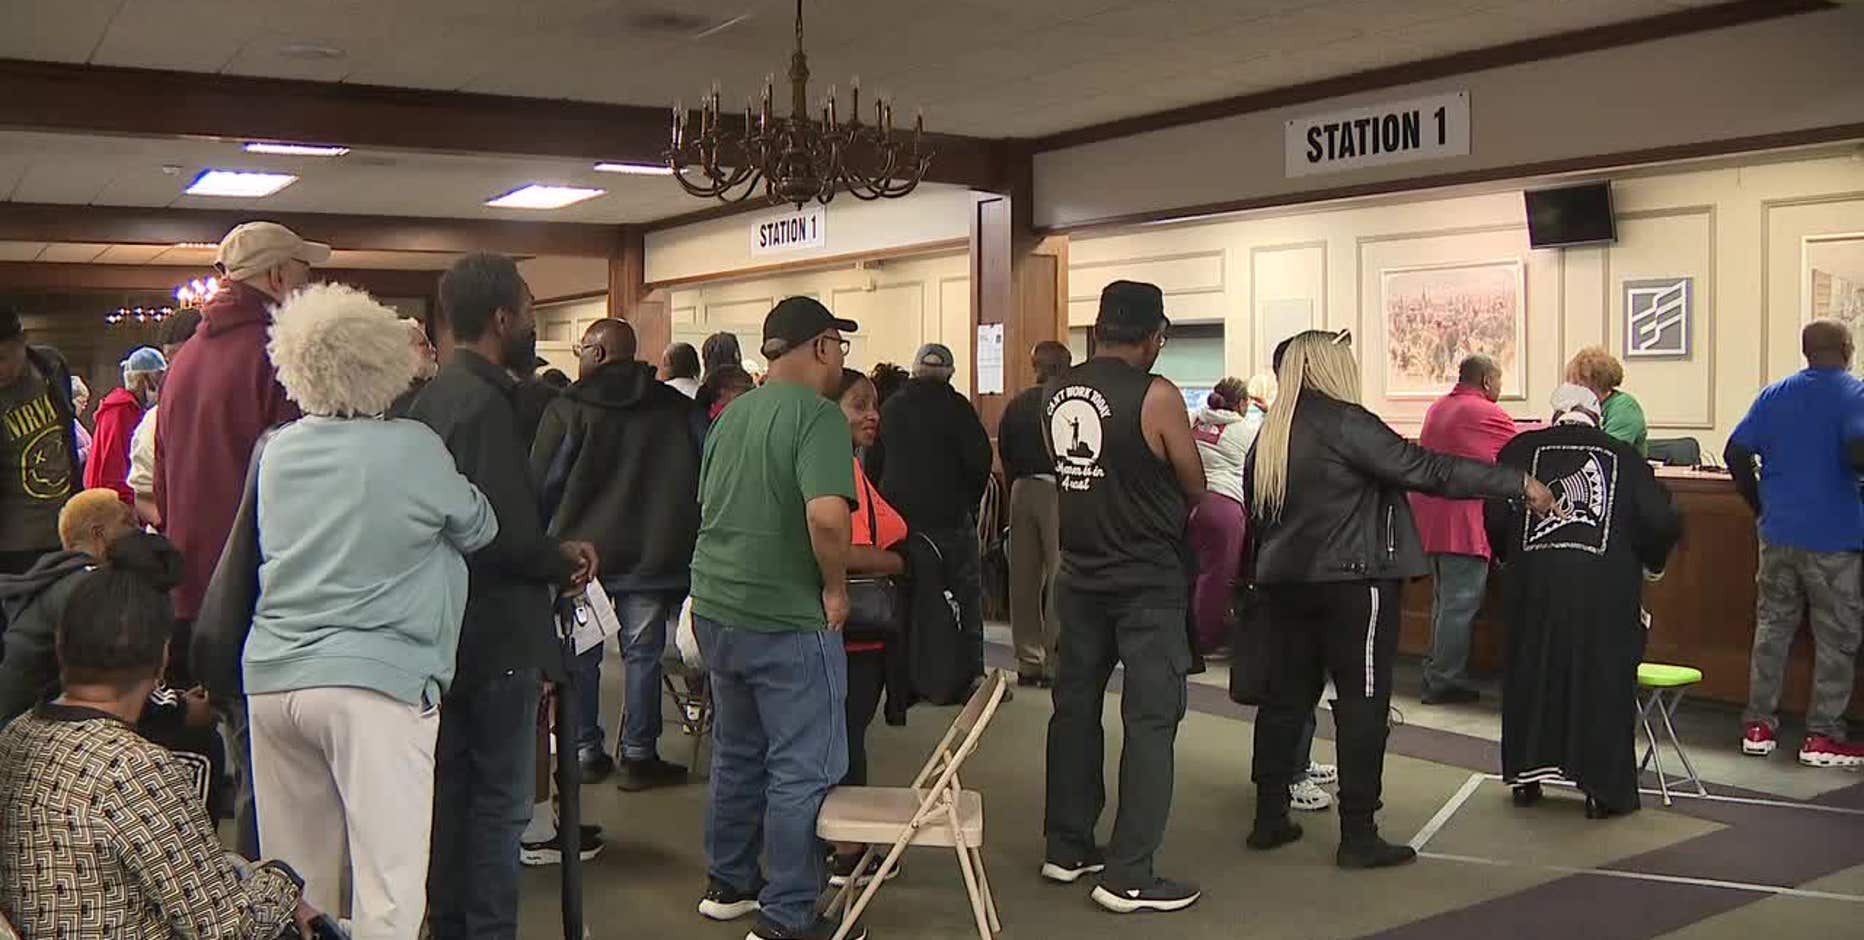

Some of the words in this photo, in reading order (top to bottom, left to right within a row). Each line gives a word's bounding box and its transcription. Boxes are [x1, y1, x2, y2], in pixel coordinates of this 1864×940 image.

[1307, 110, 1420, 164] STATION
[1434, 106, 1446, 145] 1
[760, 217, 806, 247] STATION
[811, 215, 817, 239] 1
[1066, 385, 1093, 398] WORK
[1090, 390, 1112, 418] TODAY
[1082, 464, 1092, 477] is
[1092, 465, 1105, 477] in
